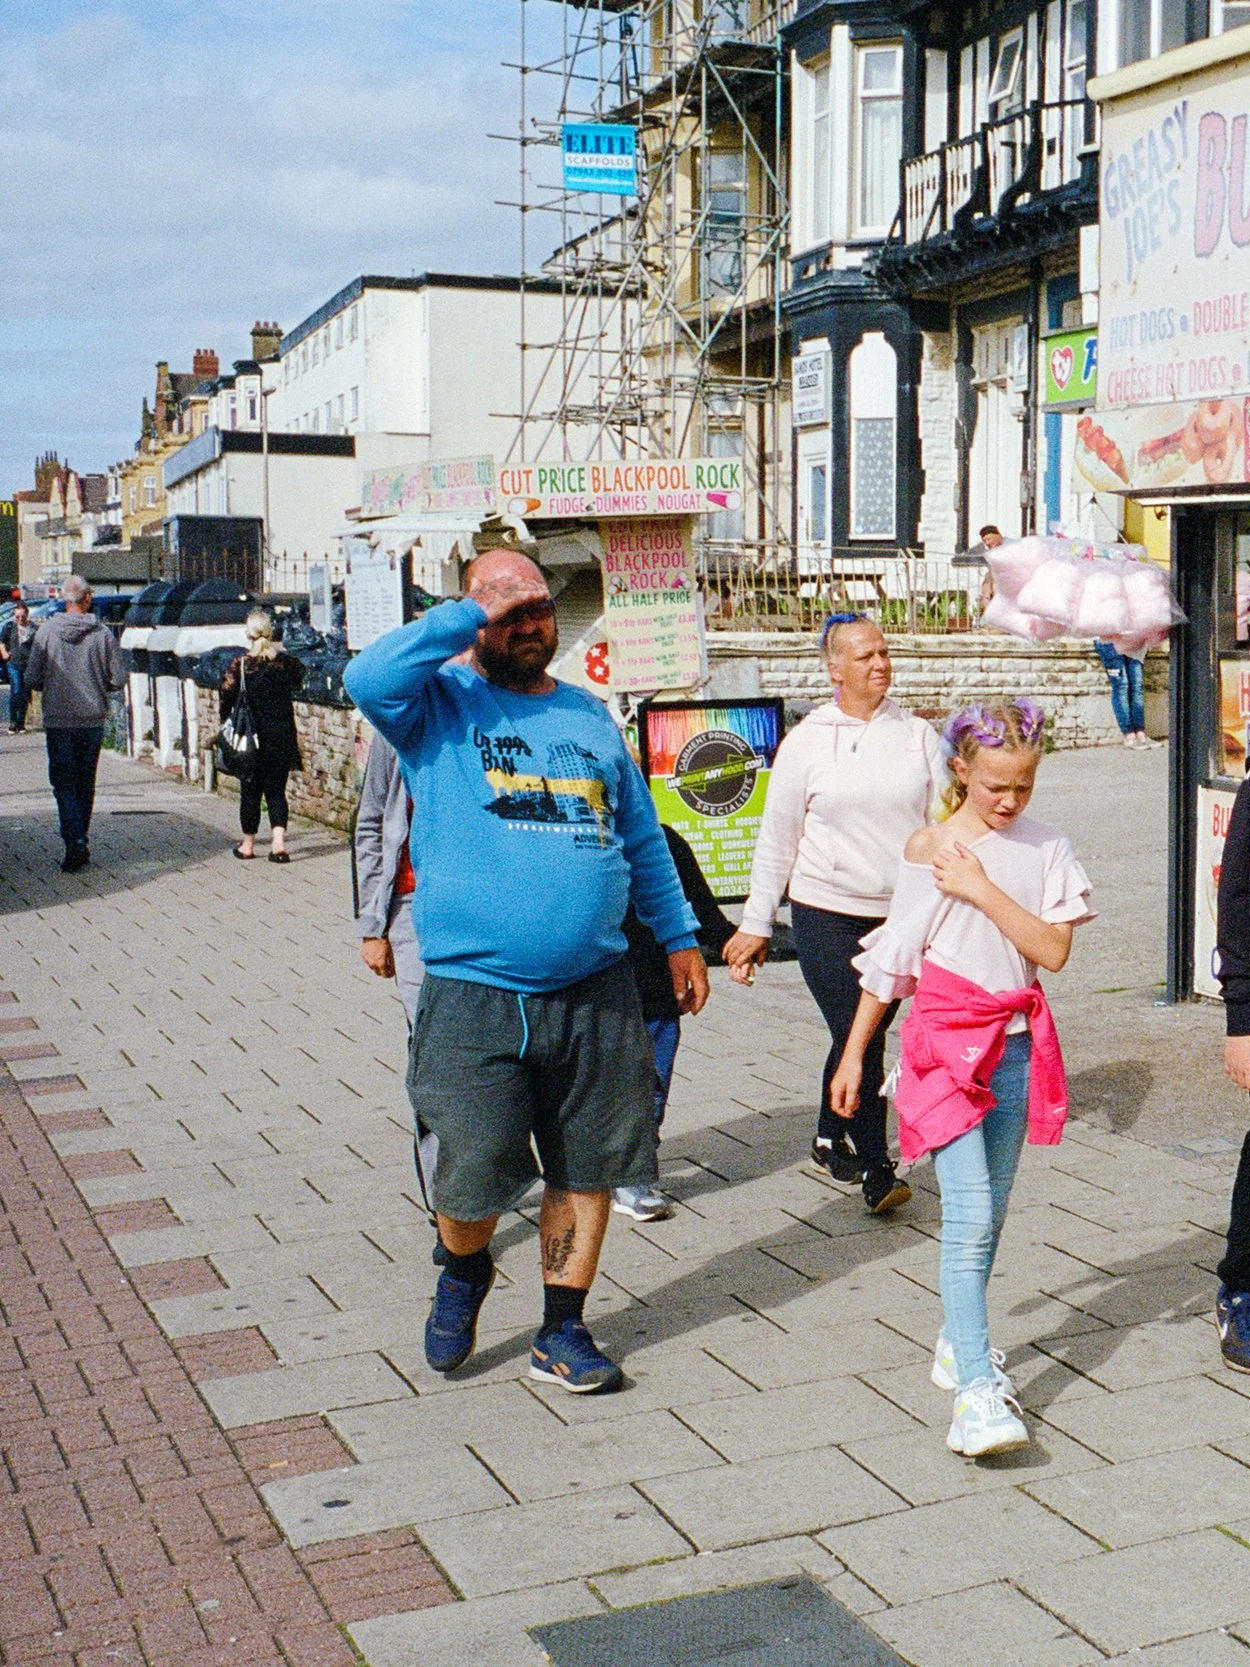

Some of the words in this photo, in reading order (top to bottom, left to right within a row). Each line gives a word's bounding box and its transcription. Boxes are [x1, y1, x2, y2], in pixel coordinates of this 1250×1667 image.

[567, 156, 631, 167] SCAFFOLDS
[1103, 100, 1189, 221] GREASY
[1124, 178, 1182, 284] JOE'S
[1109, 314, 1136, 350] HOT
[1140, 307, 1175, 345] DOGS
[1193, 292, 1249, 337] DOUBLE
[1107, 363, 1151, 404] CHEESE
[1155, 359, 1185, 398] HOT
[1188, 355, 1227, 393] DOGS
[499, 469, 533, 495] CUT
[537, 466, 586, 494] PRICE
[591, 464, 691, 494] BLACKPOOL
[696, 463, 741, 490] ROCK
[549, 496, 585, 515] FUDGE
[595, 495, 648, 513] DUMMIES
[657, 493, 702, 510] NOUGAT
[608, 532, 683, 553] DELICIOUS
[606, 551, 689, 573] BLACKPOOL
[629, 570, 668, 590] ROCK
[609, 593, 628, 609] ALL
[632, 592, 658, 607] HALF
[663, 590, 692, 605] PRICE
[678, 734, 708, 772] GARMENT
[708, 730, 747, 752] PRINTING
[695, 777, 754, 817] SPECIALISTS
